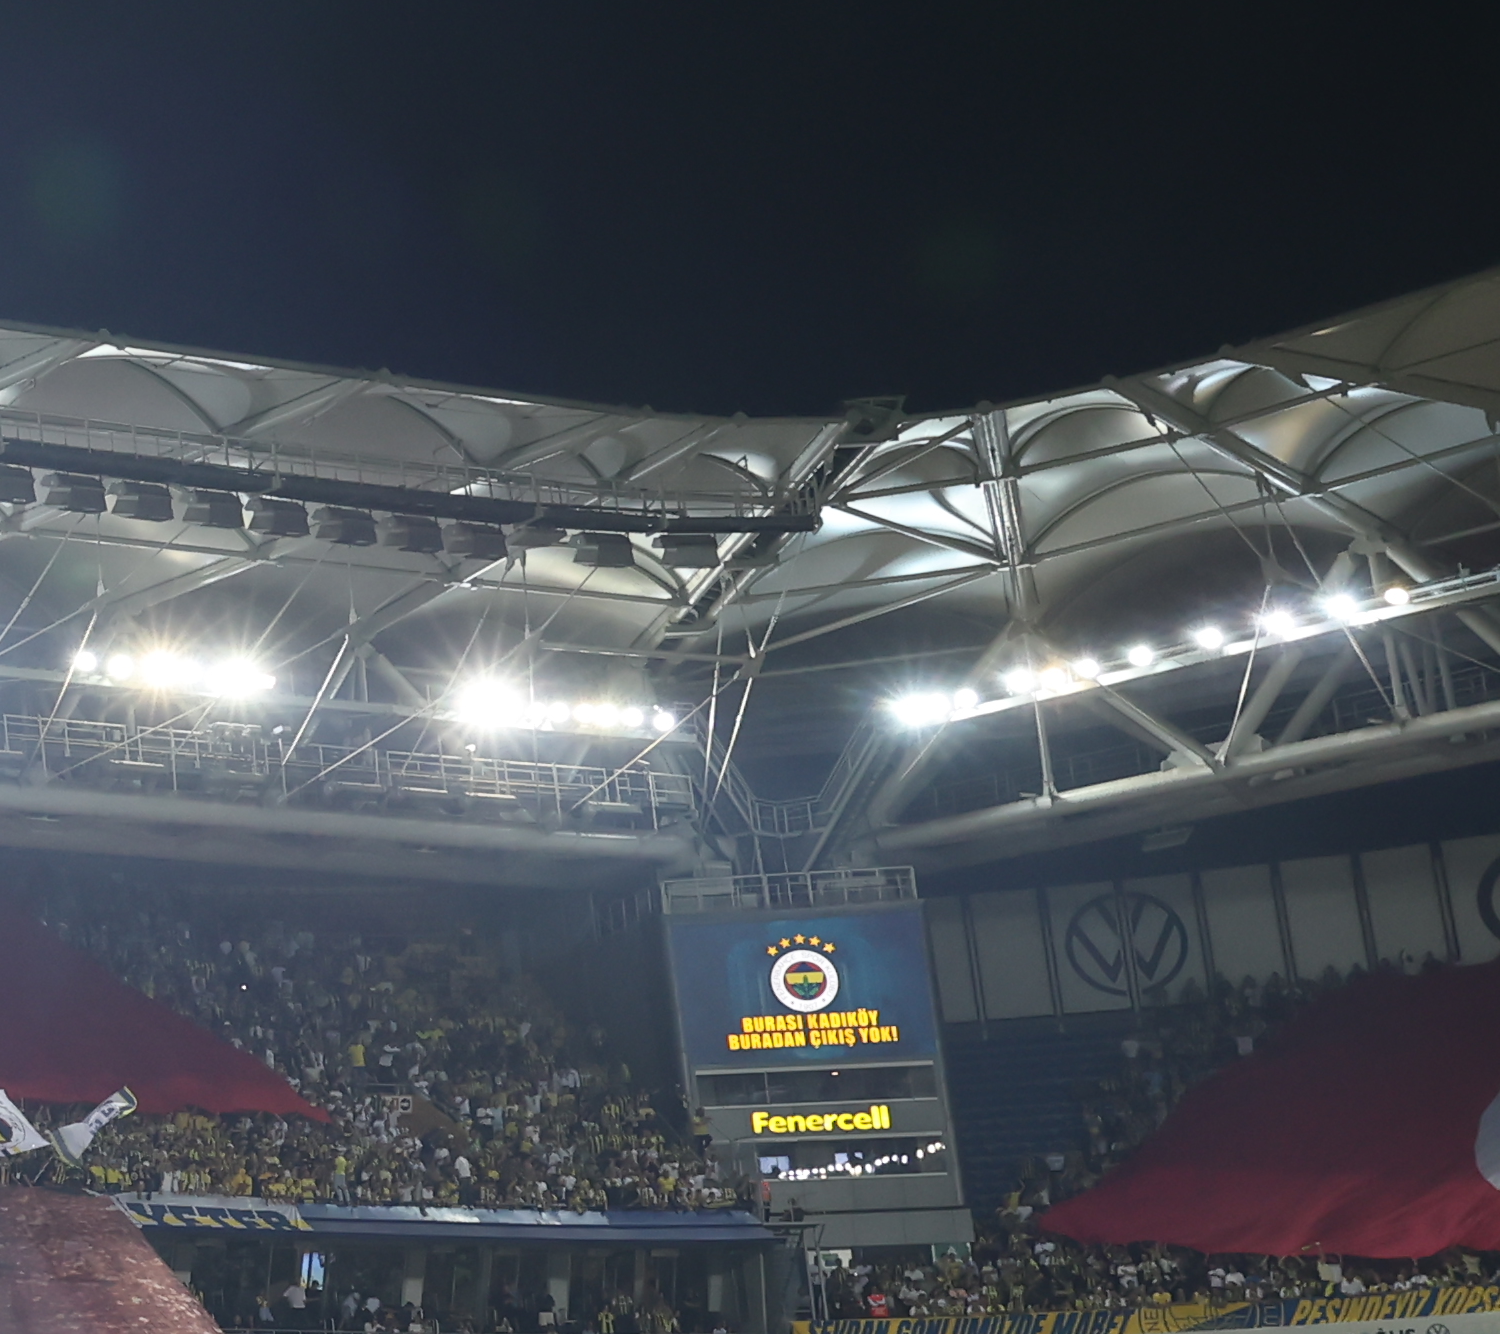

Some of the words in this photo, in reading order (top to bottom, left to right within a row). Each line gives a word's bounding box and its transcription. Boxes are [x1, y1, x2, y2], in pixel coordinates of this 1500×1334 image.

[742, 1014, 803, 1033] BURASI
[806, 1007, 879, 1030] KADIKÖY
[727, 1030, 806, 1051] BURADAN
[809, 1027, 856, 1049] ÇIKIŞ
[858, 1025, 899, 1044] YOK!
[751, 1104, 891, 1134] Fenercell
